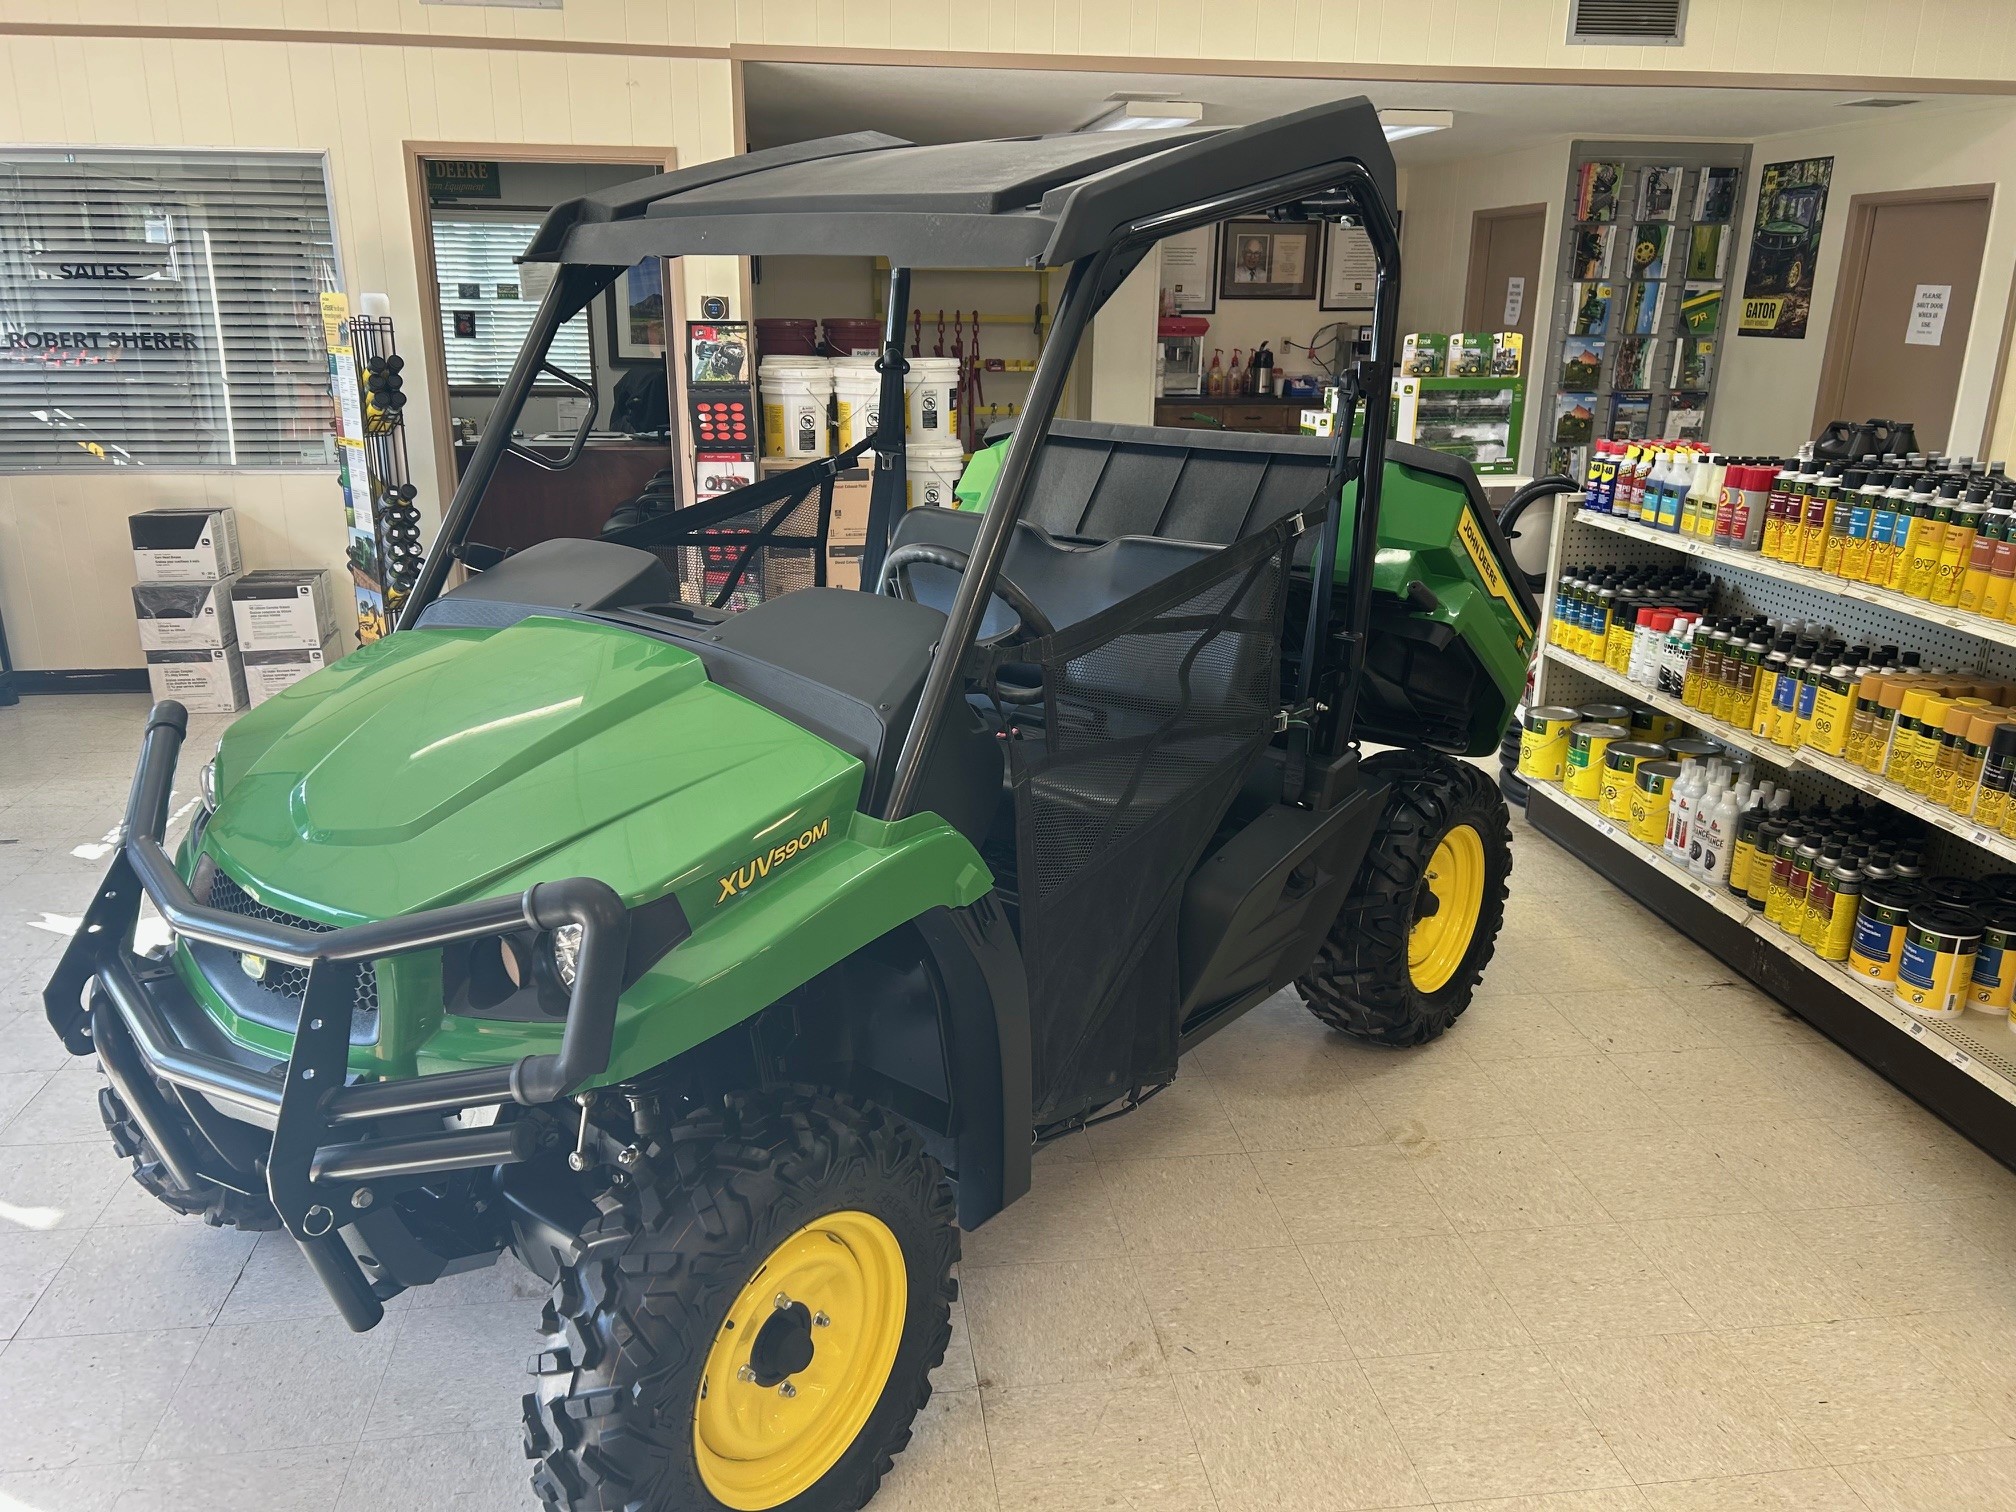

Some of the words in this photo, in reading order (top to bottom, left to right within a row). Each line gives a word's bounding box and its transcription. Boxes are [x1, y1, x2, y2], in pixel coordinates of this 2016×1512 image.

[435, 161, 488, 179] DEERE
[445, 181, 485, 193] Equipment
[59, 263, 131, 280] SALES
[1746, 302, 1776, 319] GATOR
[1689, 311, 1708, 328] 7R
[7, 332, 102, 350] ROBERT
[107, 332, 199, 350] SHERER
[1463, 520, 1480, 554] JOHN
[1478, 549, 1498, 588] DEERE
[714, 816, 830, 907] XUV590M
